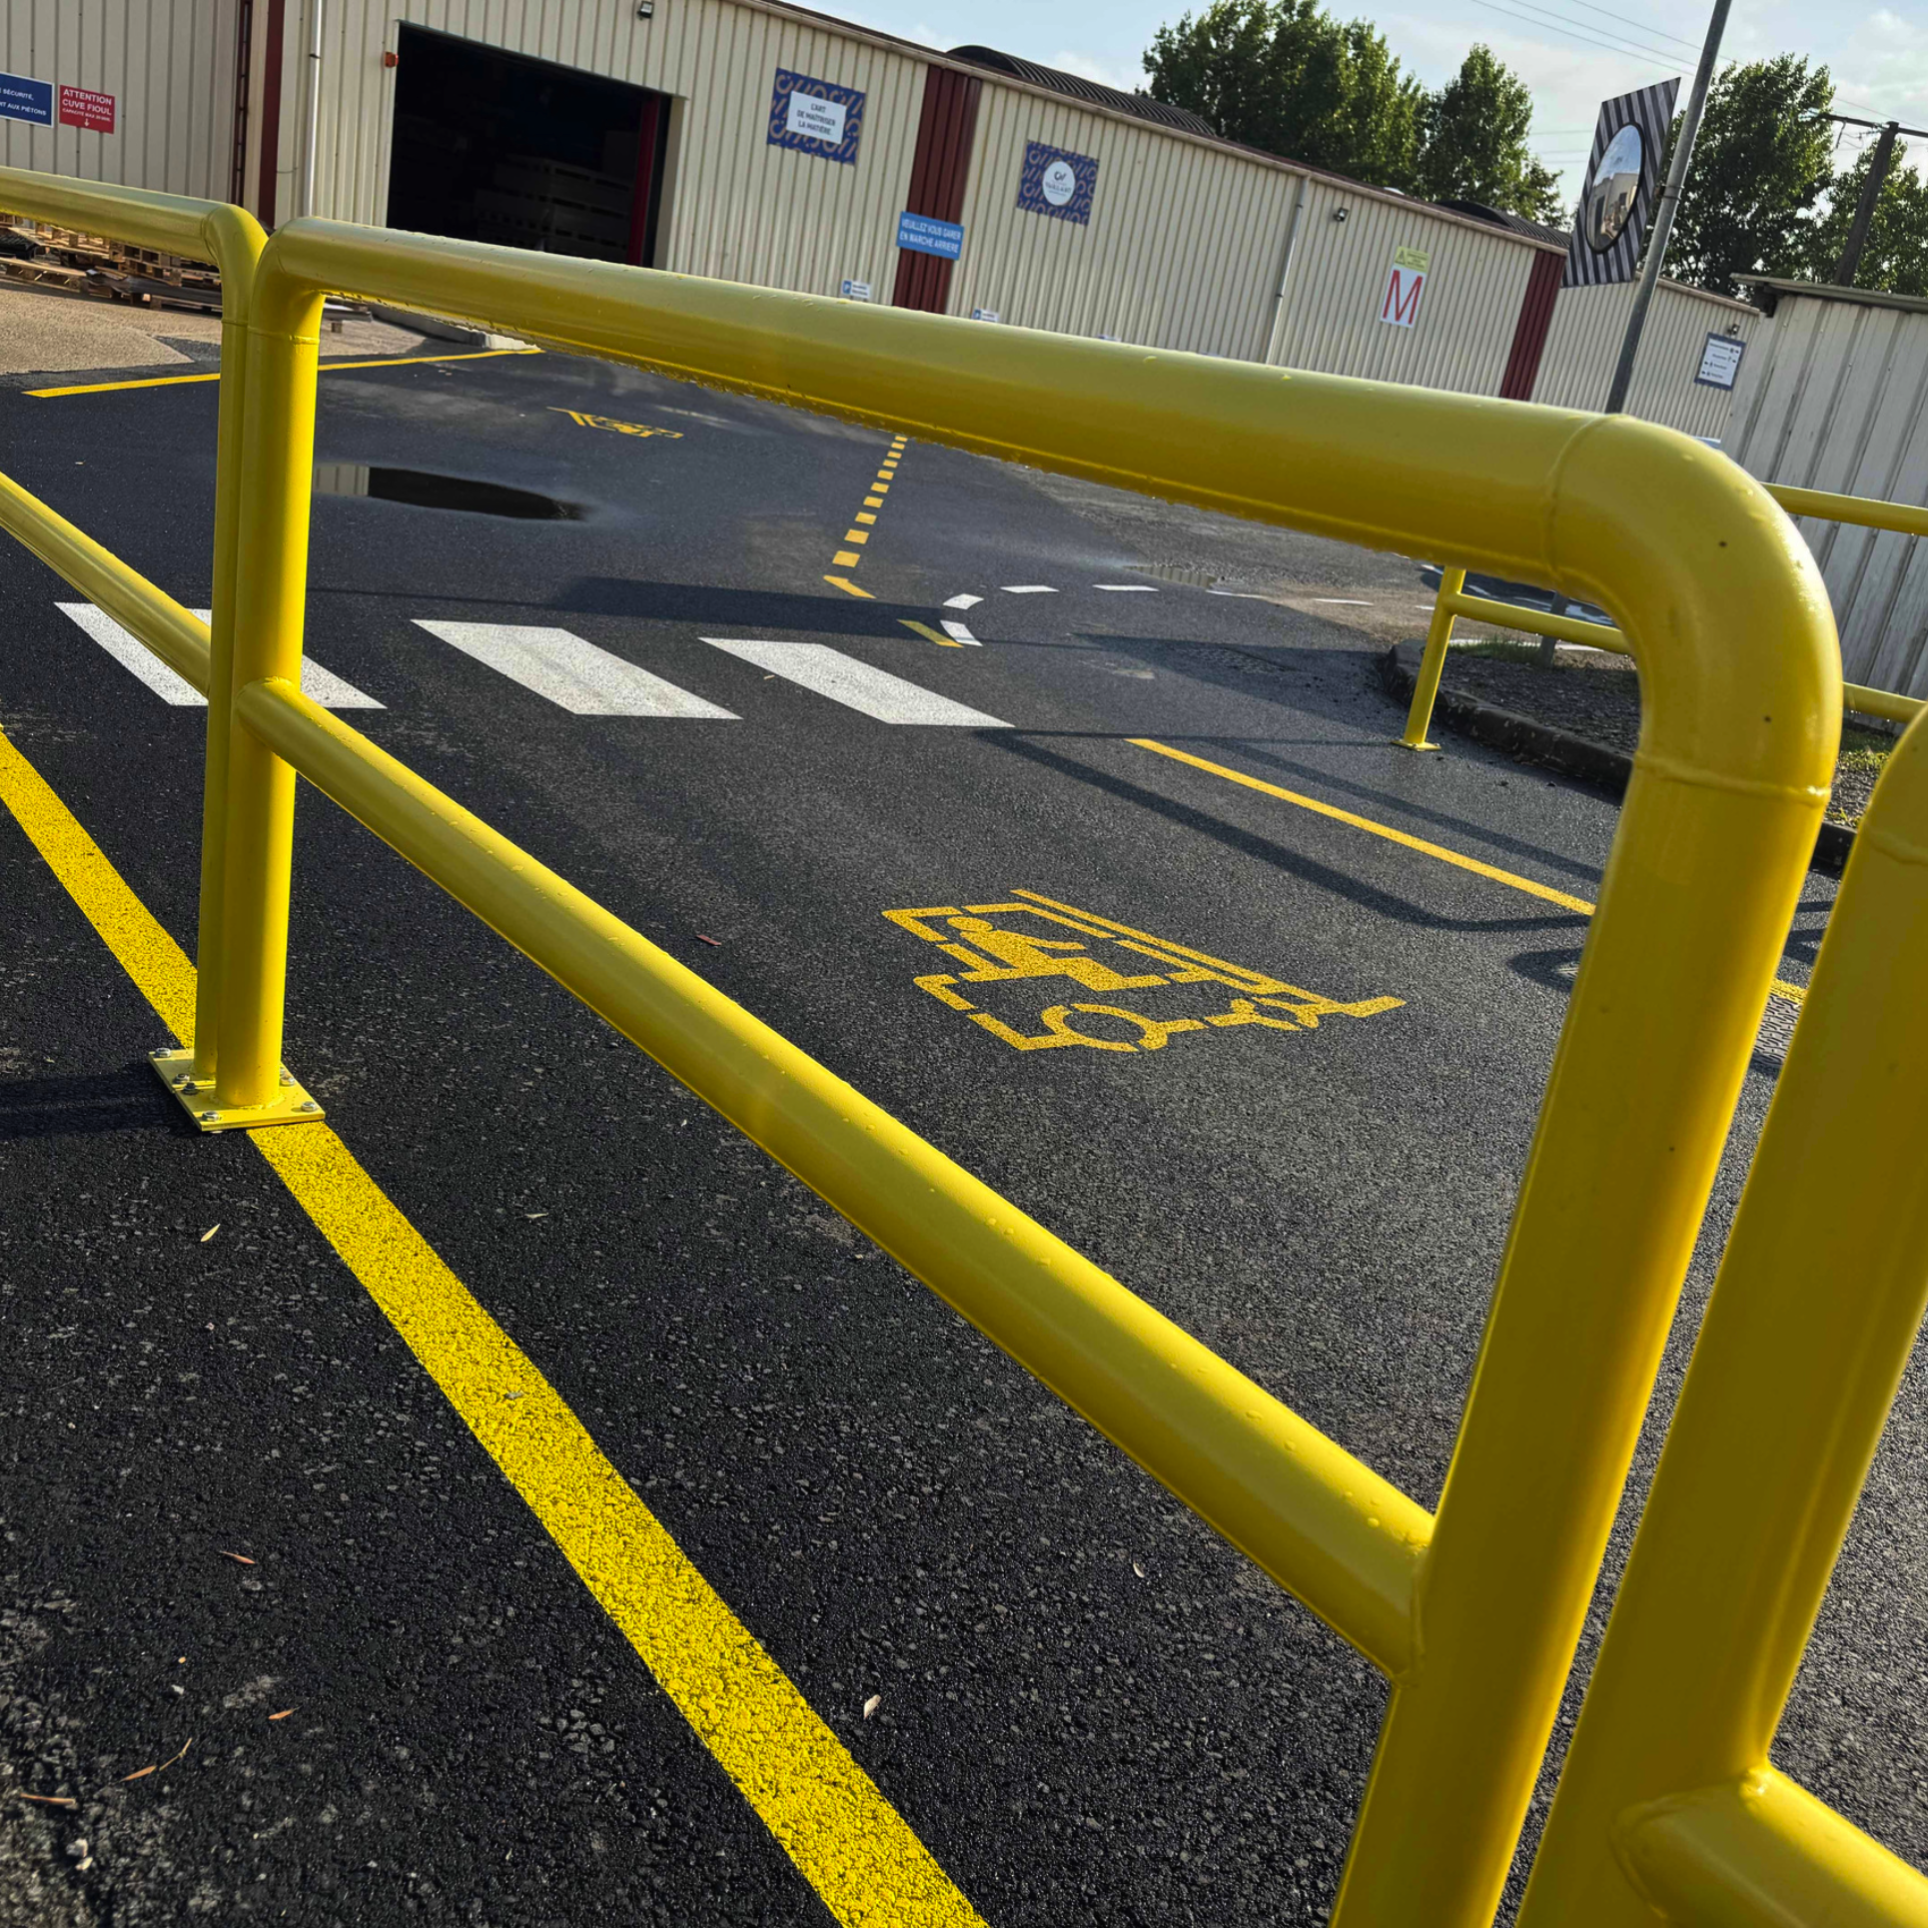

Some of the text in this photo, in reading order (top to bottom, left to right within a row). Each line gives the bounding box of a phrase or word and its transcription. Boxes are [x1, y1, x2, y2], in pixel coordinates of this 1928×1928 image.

[63, 88, 112, 105] ATTENTION
[21, 105, 47, 116] PIÉTONS
[62, 99, 112, 116] CUVE FIOUL
[797, 110, 805, 119] DE
[798, 120, 806, 128] LA
[902, 218, 961, 241] VEUILLEZ VOUS GARER
[900, 231, 908, 241] EN
[910, 233, 933, 248] MARCHE
[1382, 269, 1423, 325] M
